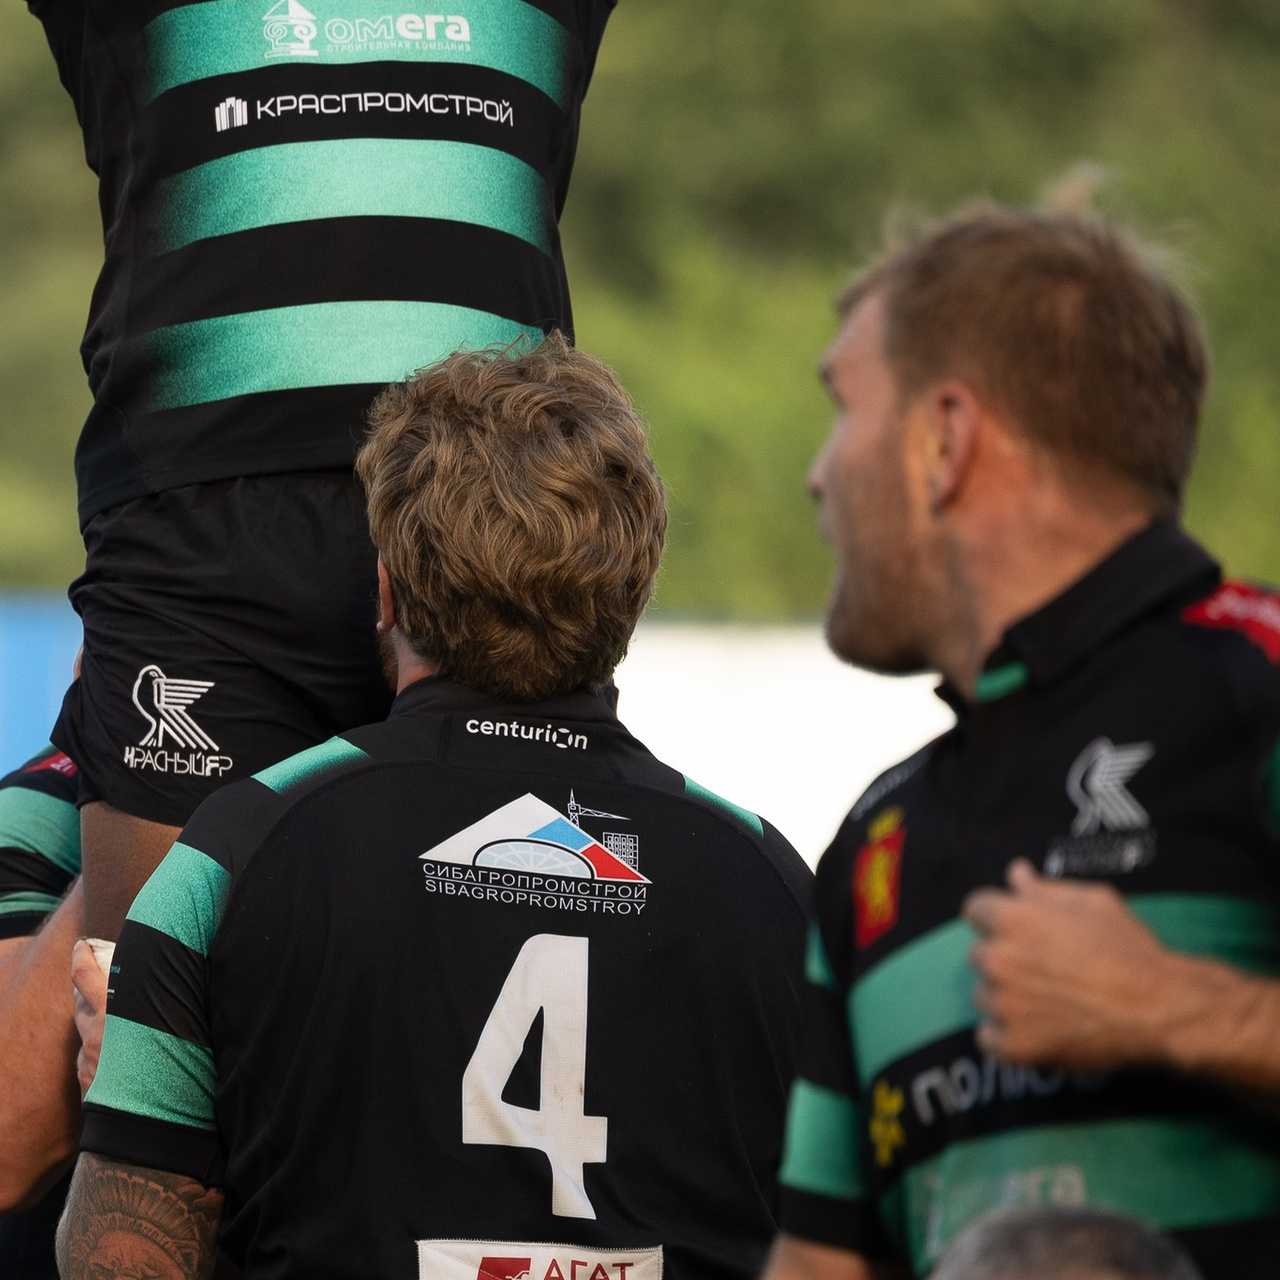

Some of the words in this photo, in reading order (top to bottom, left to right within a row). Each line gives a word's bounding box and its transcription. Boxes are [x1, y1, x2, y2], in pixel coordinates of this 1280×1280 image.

[326, 41, 410, 53] СТРОИТЕЛЬНАЯ
[415, 41, 471, 52] КОМПАНИЯ
[257, 92, 514, 127] КРАСПРОМСТРОЙ
[466, 719, 588, 750] centurion
[423, 863, 647, 899] СИБАГРОПРОМСТРОЙ
[425, 879, 646, 915] SIBAGROPROMSTROY
[462, 933, 607, 1220] 4
